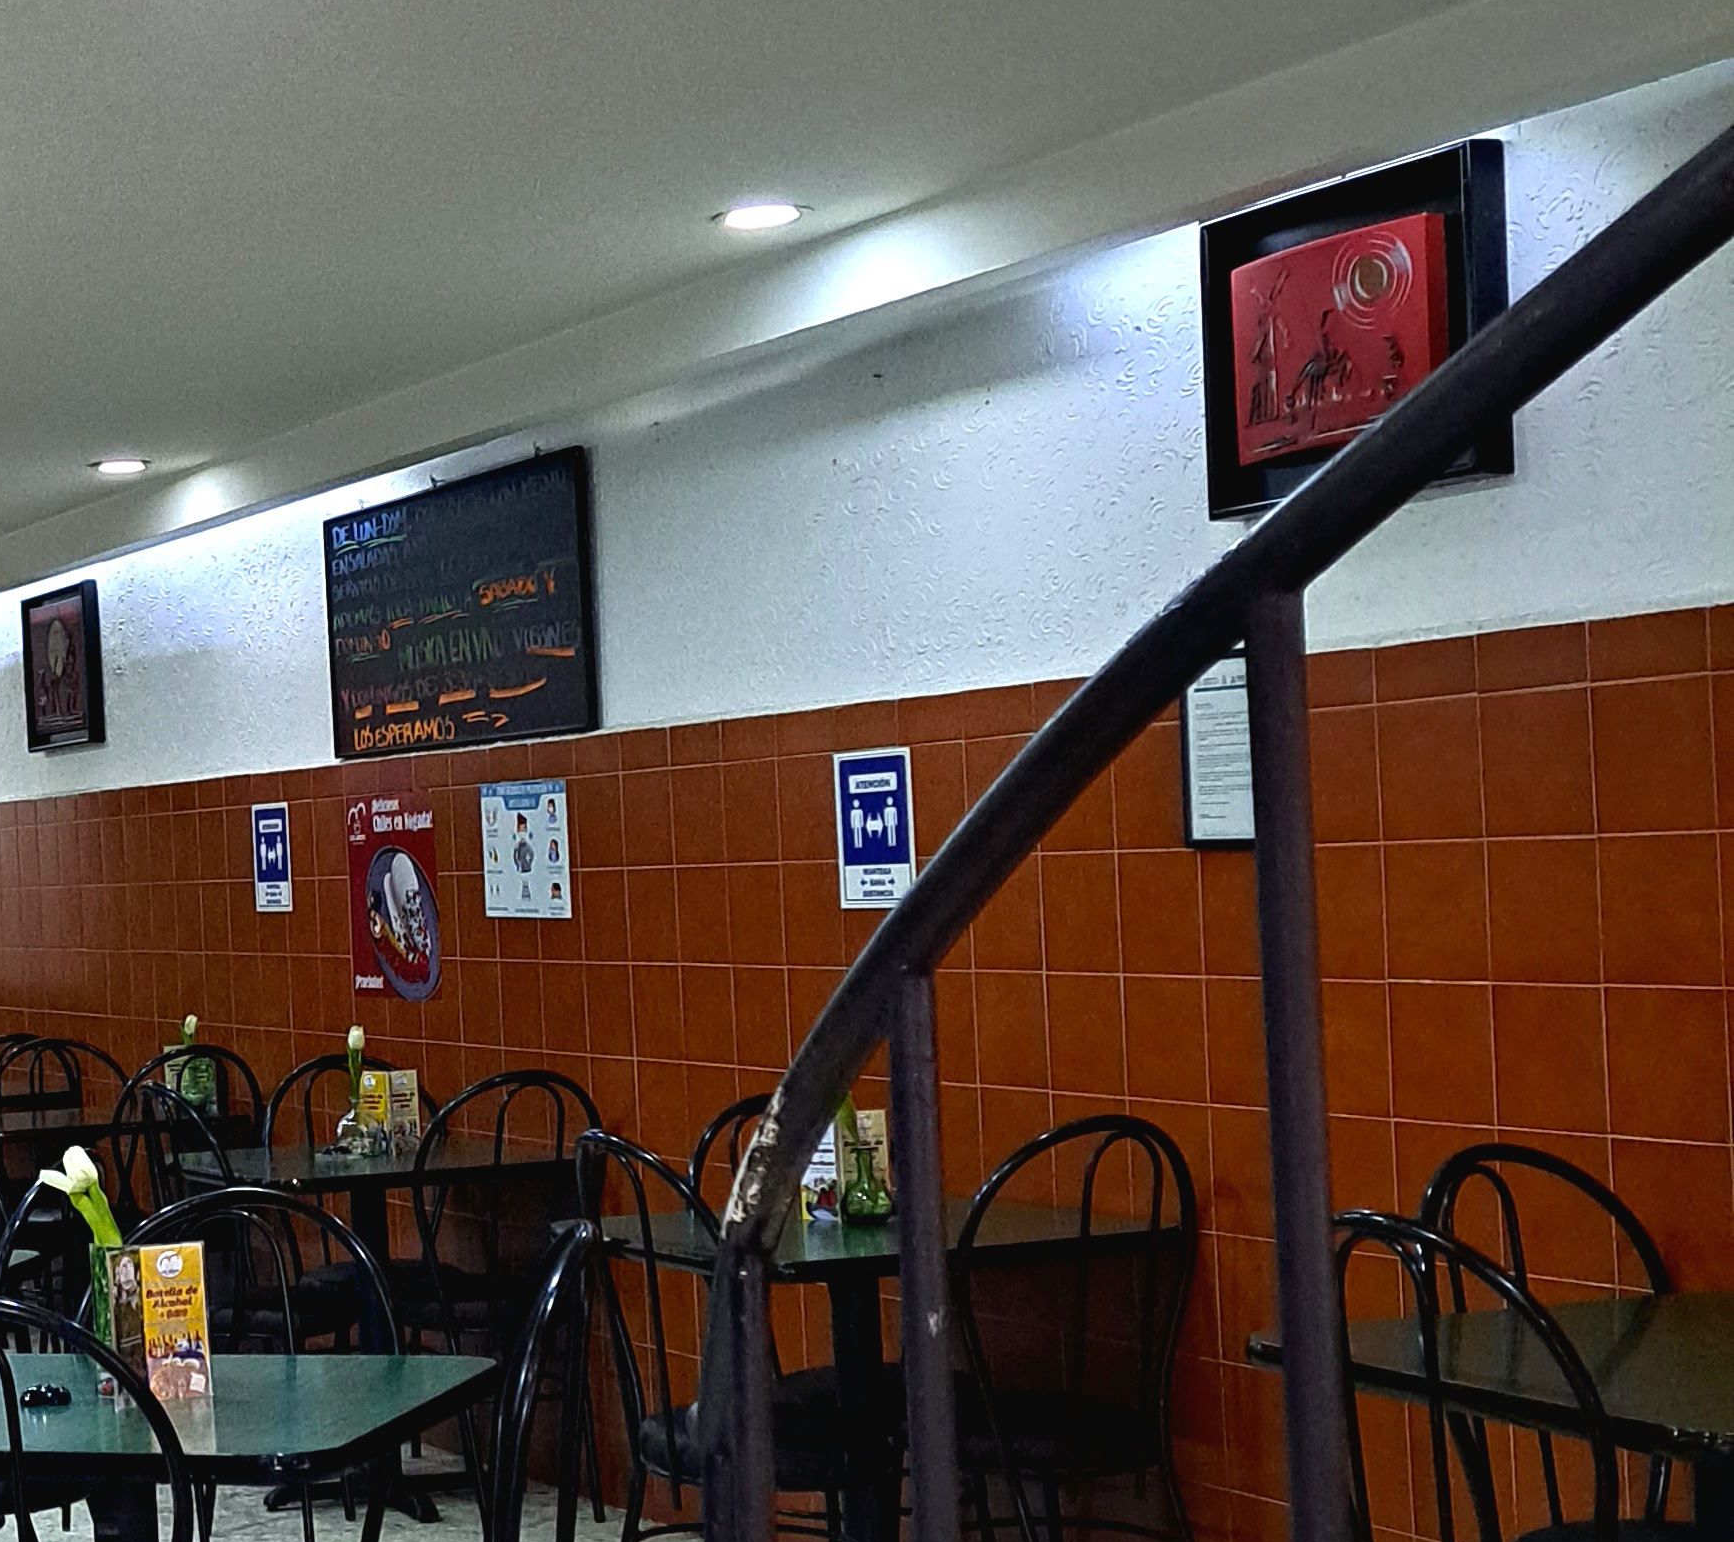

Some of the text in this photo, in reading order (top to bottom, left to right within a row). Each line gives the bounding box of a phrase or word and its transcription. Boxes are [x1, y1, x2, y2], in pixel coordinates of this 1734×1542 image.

[332, 524, 350, 550] DE
[353, 714, 456, 751] LOS ESPERAMOS
[152, 1297, 192, 1309] Alcohol
